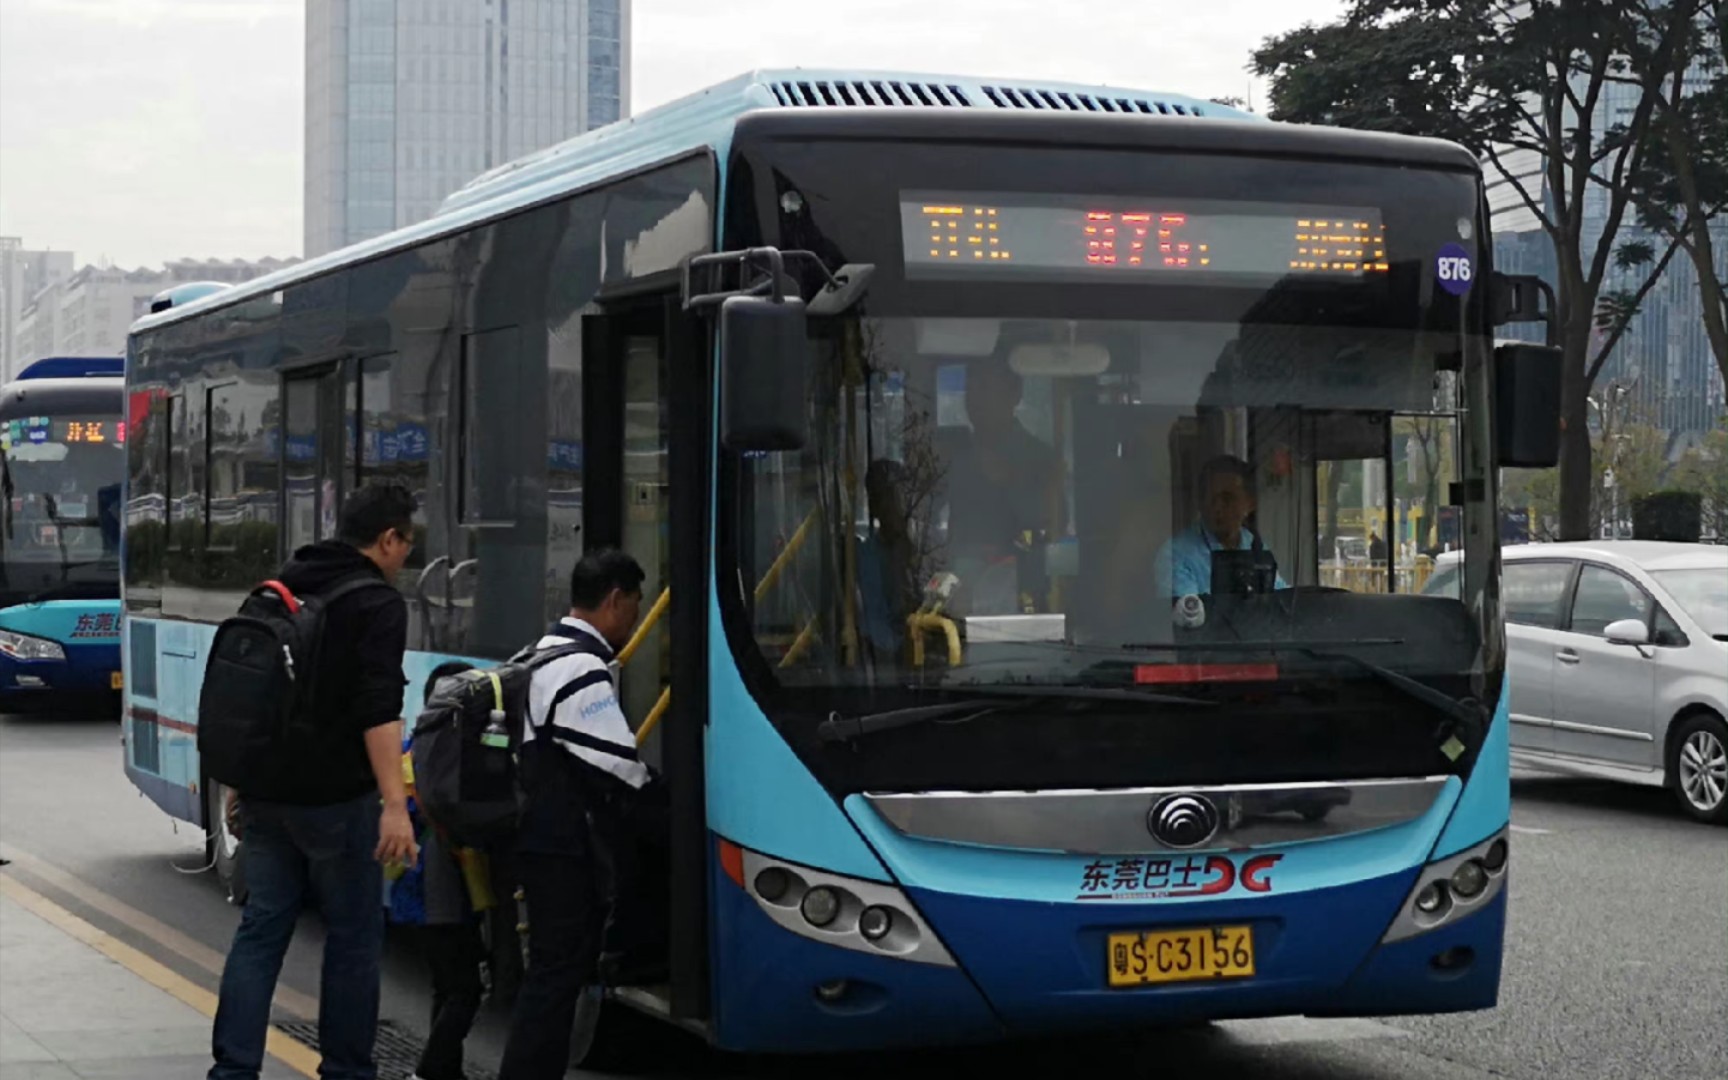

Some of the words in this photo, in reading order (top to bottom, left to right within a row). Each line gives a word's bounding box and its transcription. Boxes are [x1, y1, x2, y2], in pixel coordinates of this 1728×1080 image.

[1438, 257, 1471, 281] 876
[1080, 857, 1202, 891] 东莞巴士
